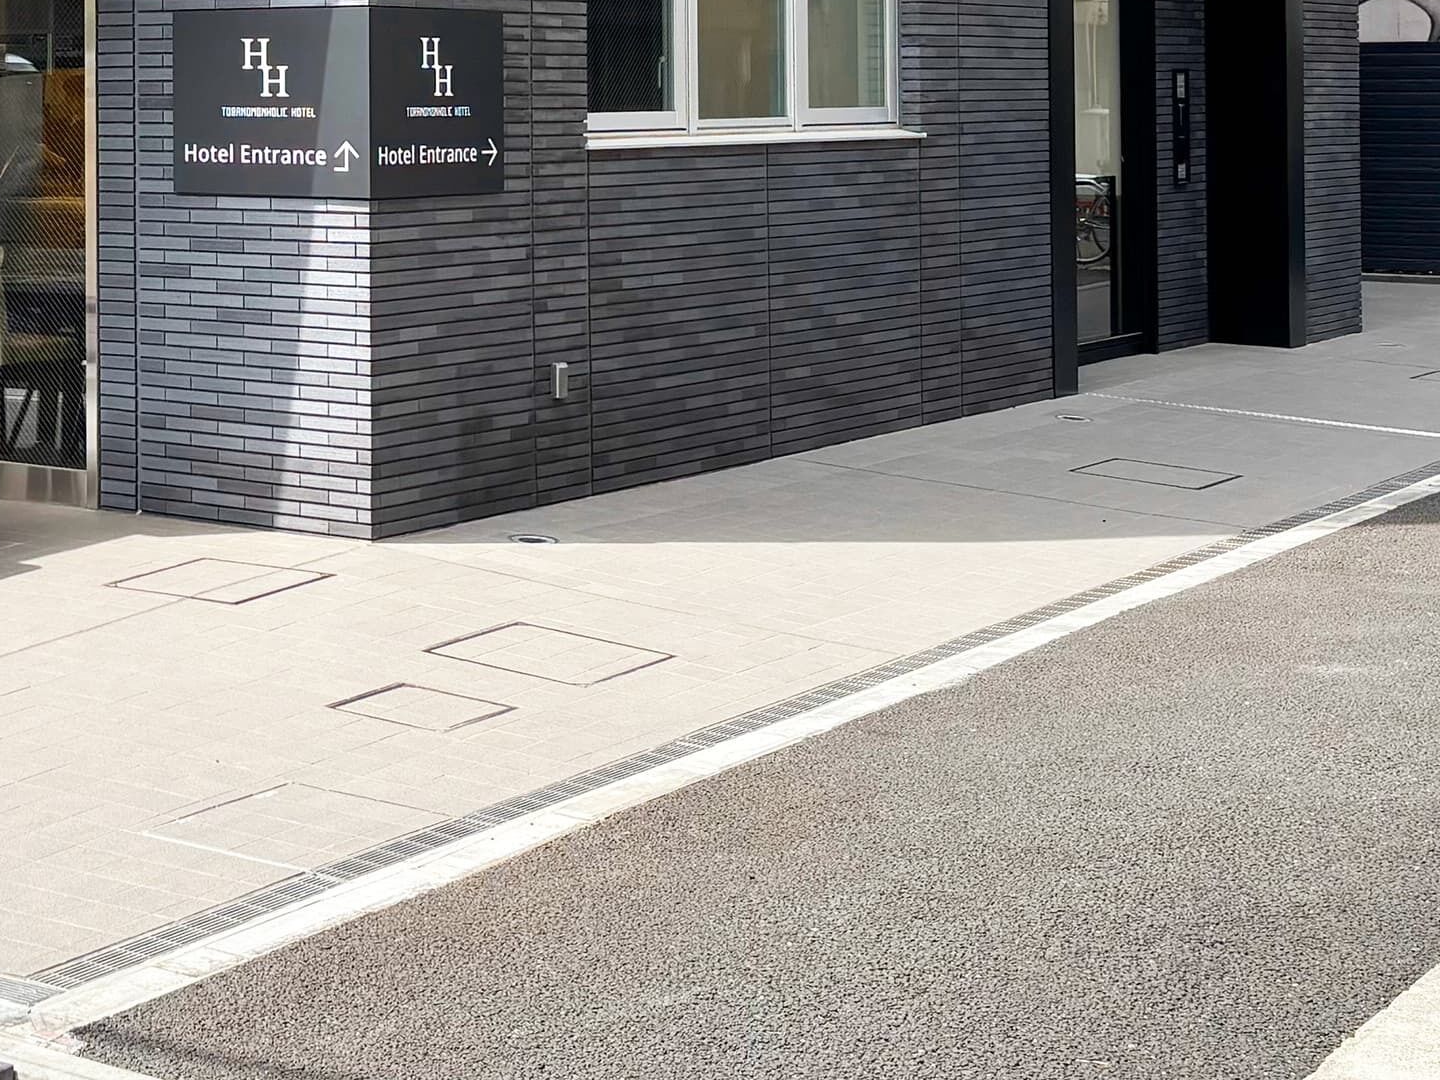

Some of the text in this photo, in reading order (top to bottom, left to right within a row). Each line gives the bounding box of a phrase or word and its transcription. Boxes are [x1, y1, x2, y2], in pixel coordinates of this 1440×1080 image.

[290, 106, 317, 119] HOTEL
[184, 143, 327, 166] Hotel Entrance
[378, 144, 478, 166] Hotel Entrance
